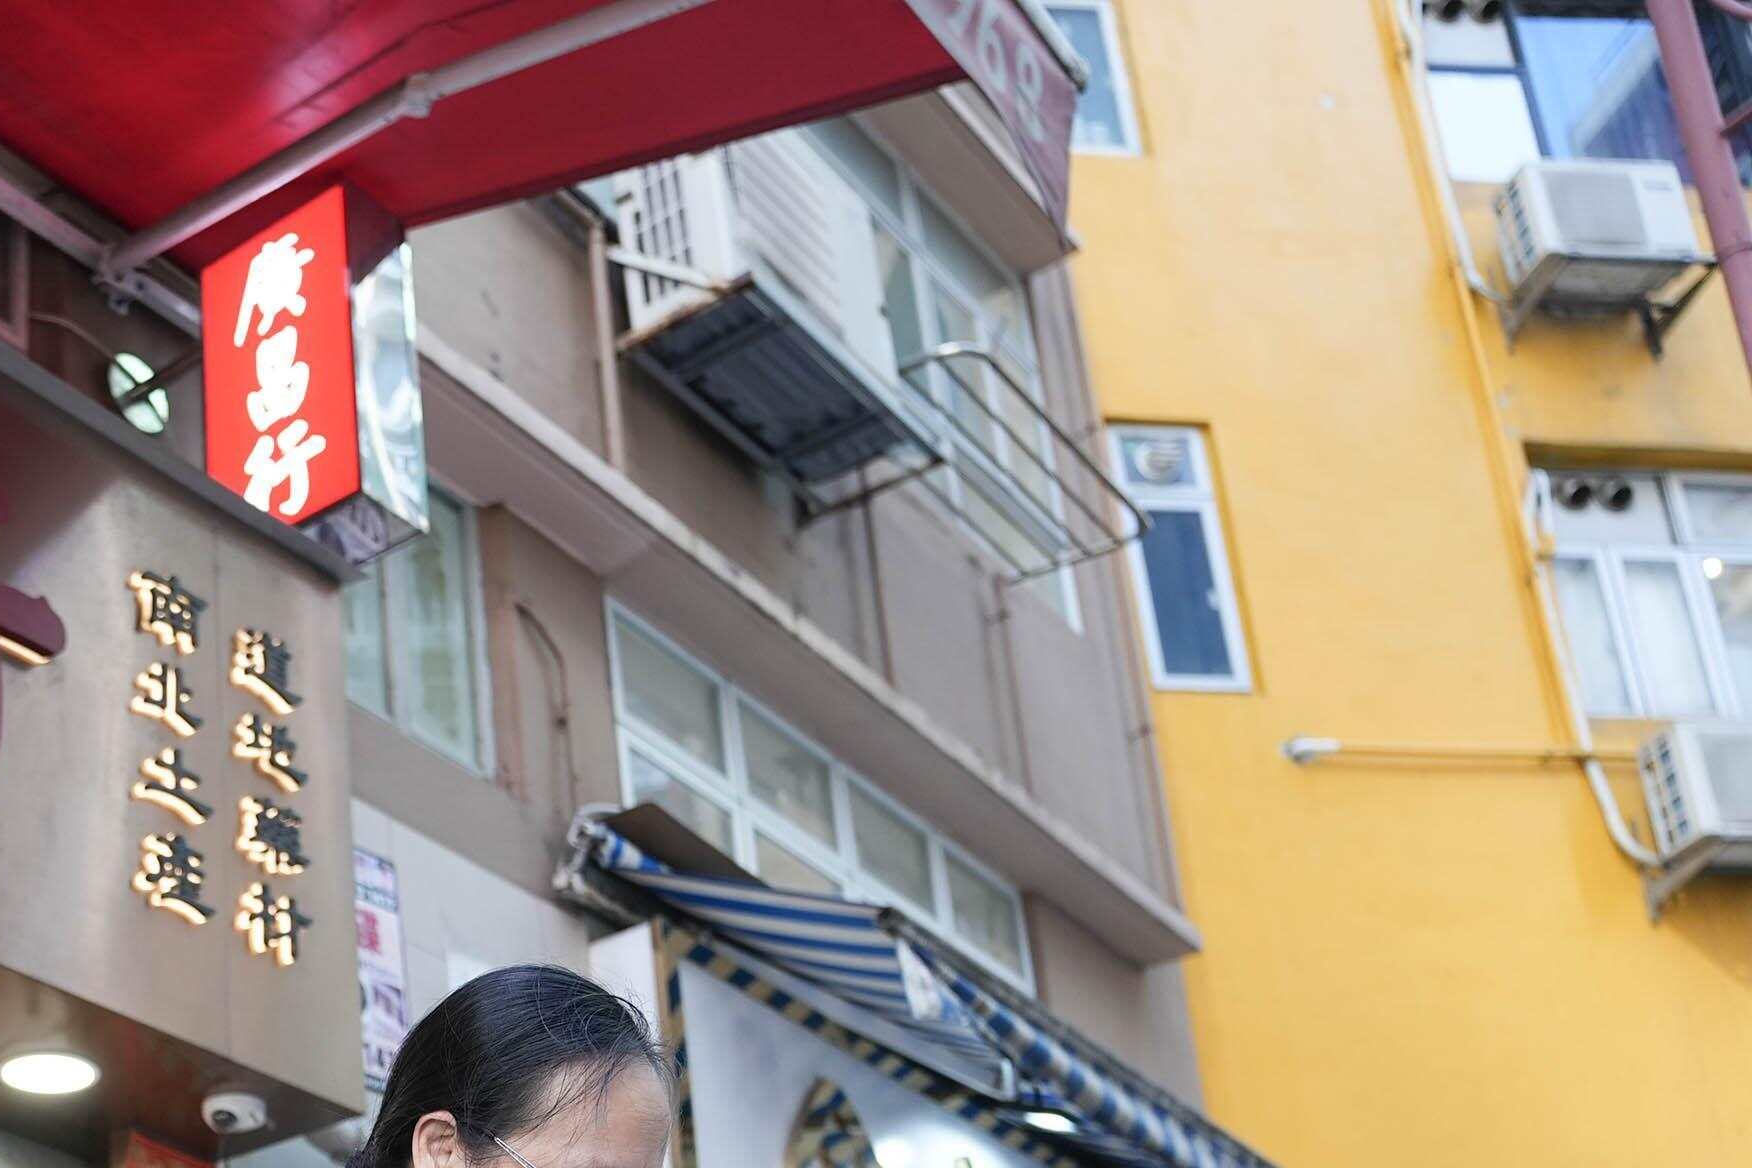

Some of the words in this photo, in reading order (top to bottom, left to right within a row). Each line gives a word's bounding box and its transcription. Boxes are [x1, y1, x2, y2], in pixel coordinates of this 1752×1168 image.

[233, 232, 327, 516] 廣昌行
[128, 567, 214, 925] 南北土產
